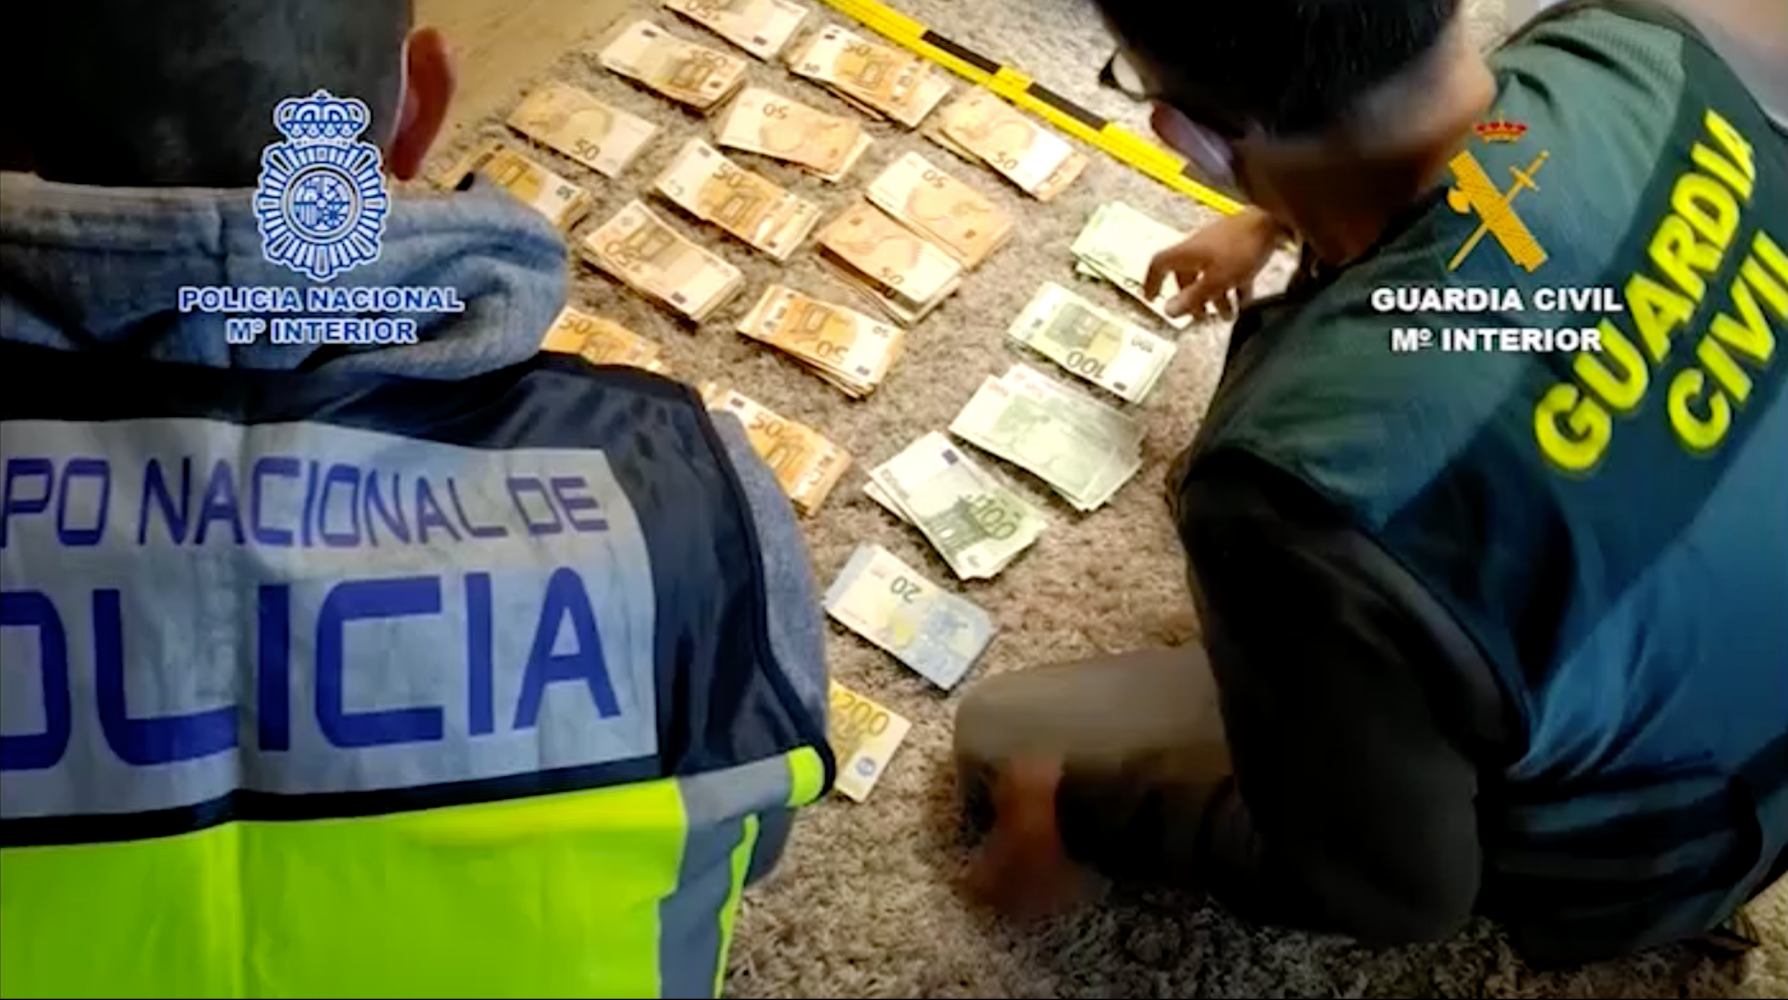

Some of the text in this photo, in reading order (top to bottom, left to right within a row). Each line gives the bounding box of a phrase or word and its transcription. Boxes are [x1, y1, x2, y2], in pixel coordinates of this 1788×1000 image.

[762, 102, 791, 121] 50
[573, 138, 601, 161] 50
[991, 151, 1020, 172] 50
[712, 161, 743, 188] 50
[921, 168, 949, 190] 50
[1534, 107, 1757, 471] GUARDIA
[558, 313, 594, 335] 50
[816, 340, 849, 366] 50
[1066, 350, 1105, 379] 100
[749, 410, 784, 439] 50
[138, 458, 508, 547] NACIONAL
[508, 476, 608, 535] DE
[971, 494, 1018, 541] 100
[890, 576, 923, 603] 20
[836, 691, 890, 737] 200
